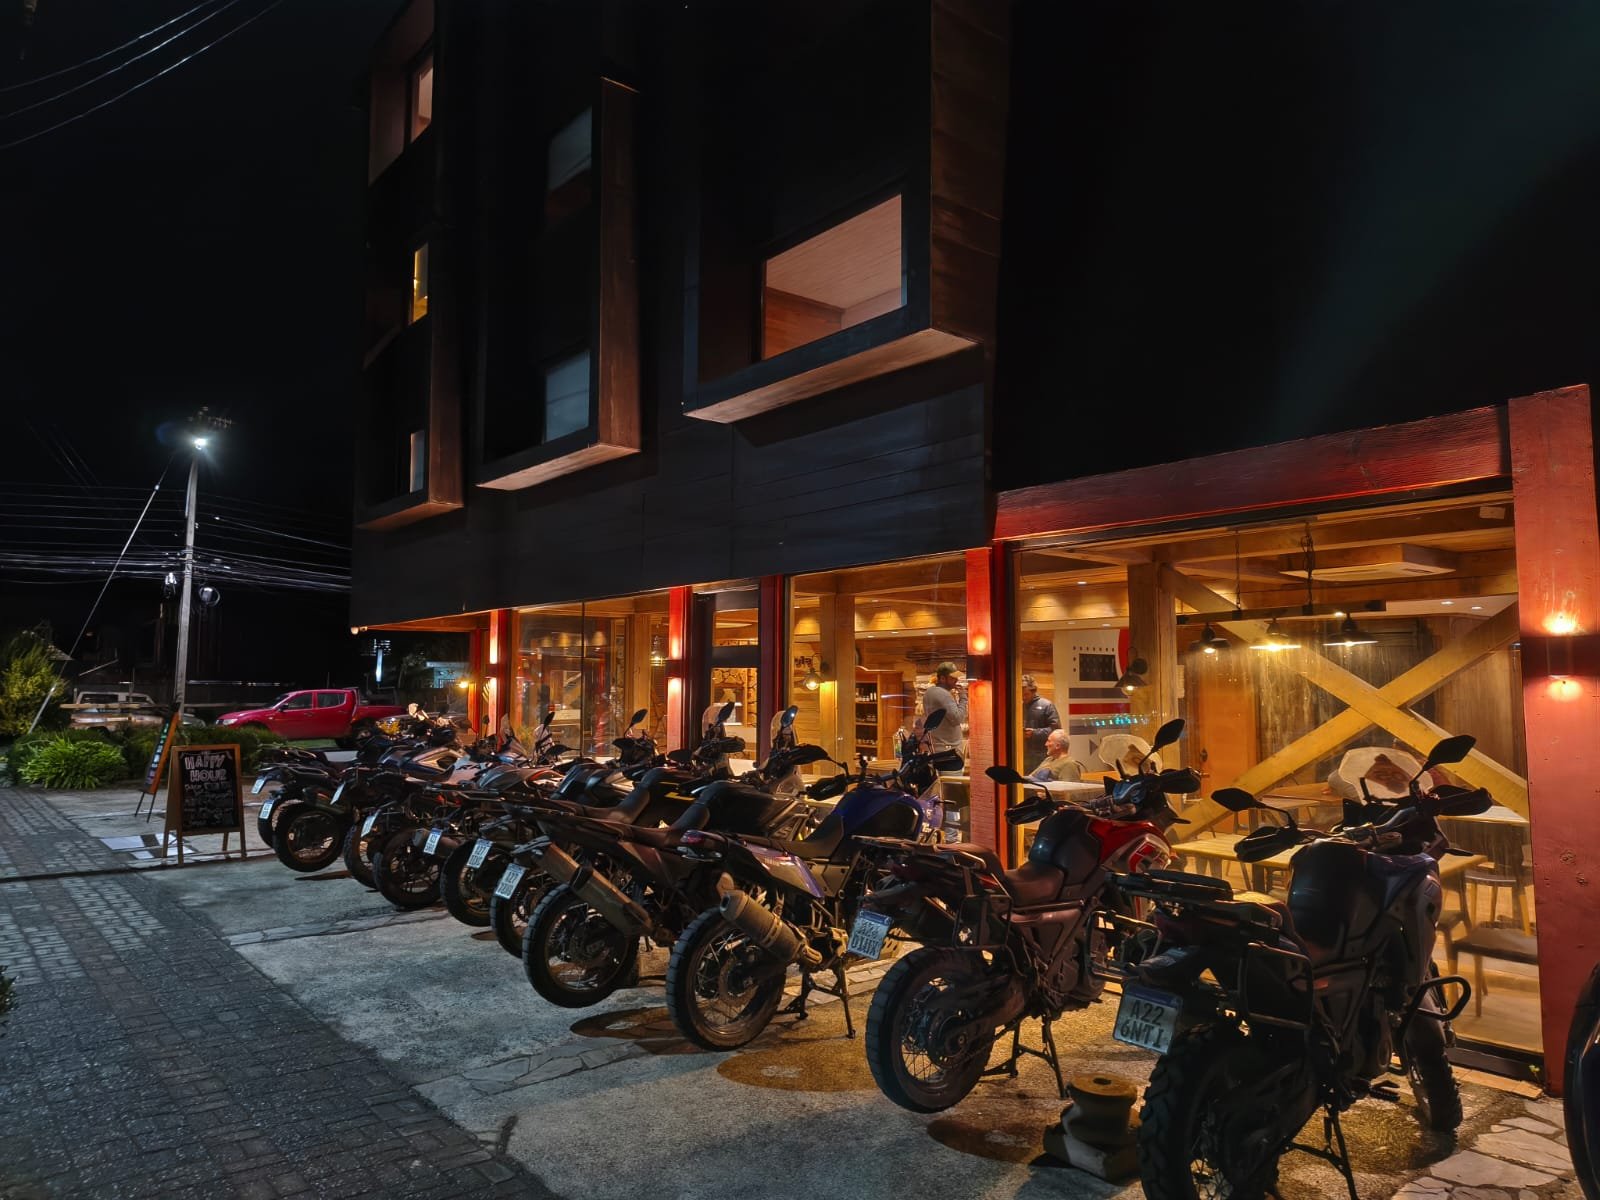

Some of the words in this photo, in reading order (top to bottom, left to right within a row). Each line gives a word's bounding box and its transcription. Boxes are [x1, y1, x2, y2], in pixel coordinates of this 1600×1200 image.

[184, 754, 226, 770] HAPPY
[190, 769, 227, 782] HOUR
[1130, 999, 1164, 1026] A22
[1120, 1020, 1164, 1048] 6NTI
